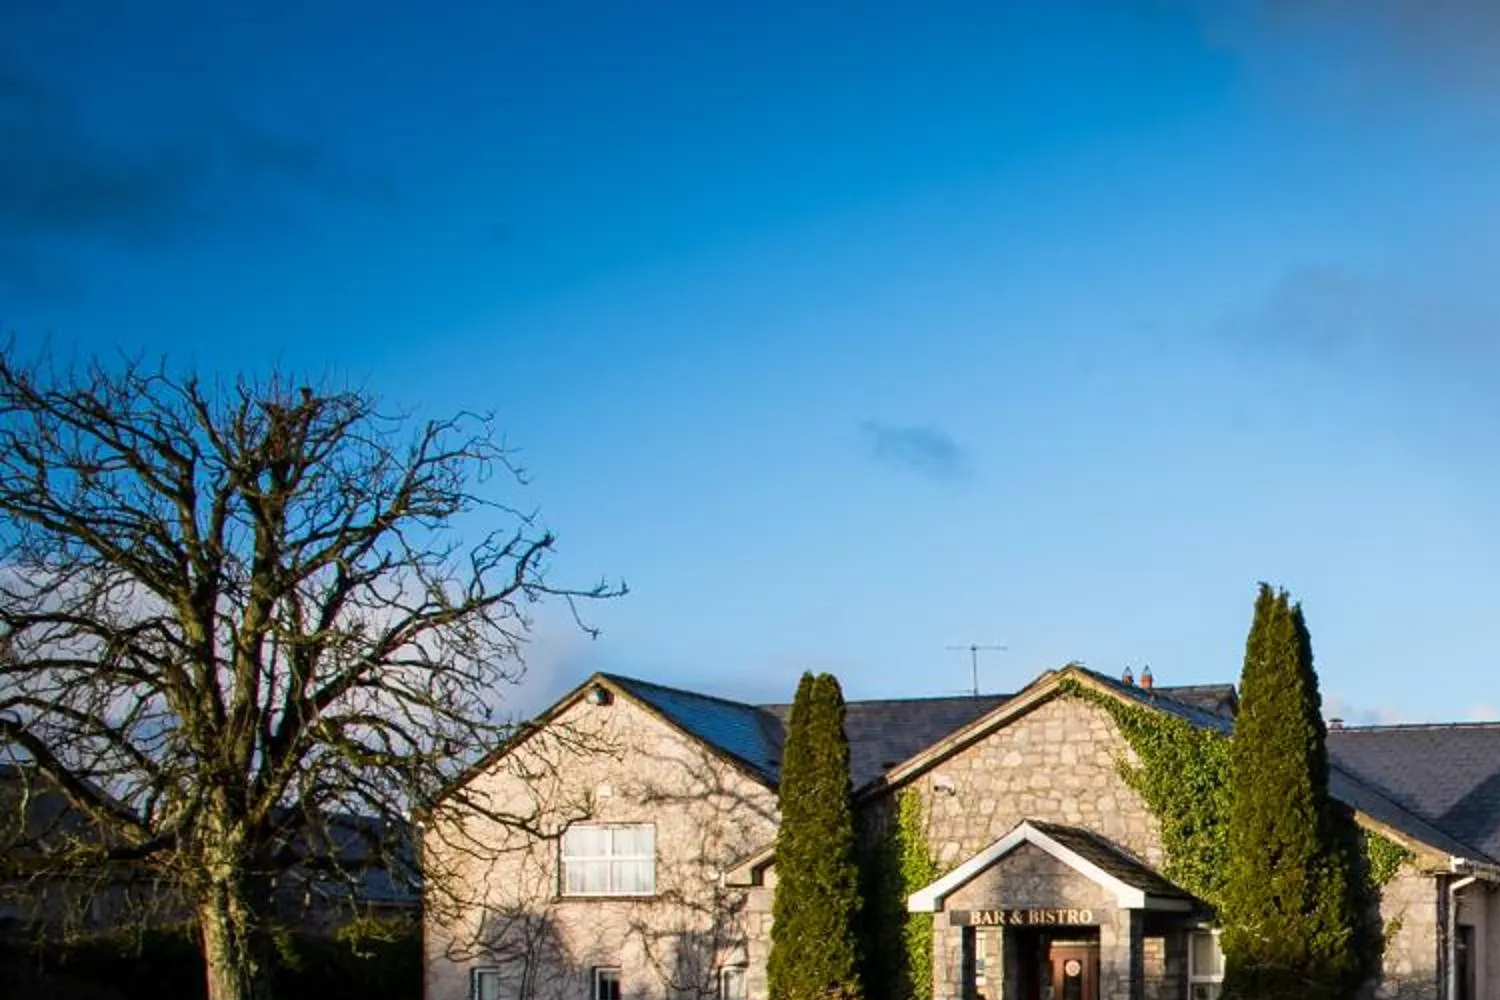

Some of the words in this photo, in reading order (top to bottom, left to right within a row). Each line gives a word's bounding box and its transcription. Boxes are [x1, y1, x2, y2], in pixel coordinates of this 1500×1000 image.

[969, 910, 1007, 925] BAR
[1009, 909, 1023, 925] &
[1029, 908, 1093, 925] BISTRO
